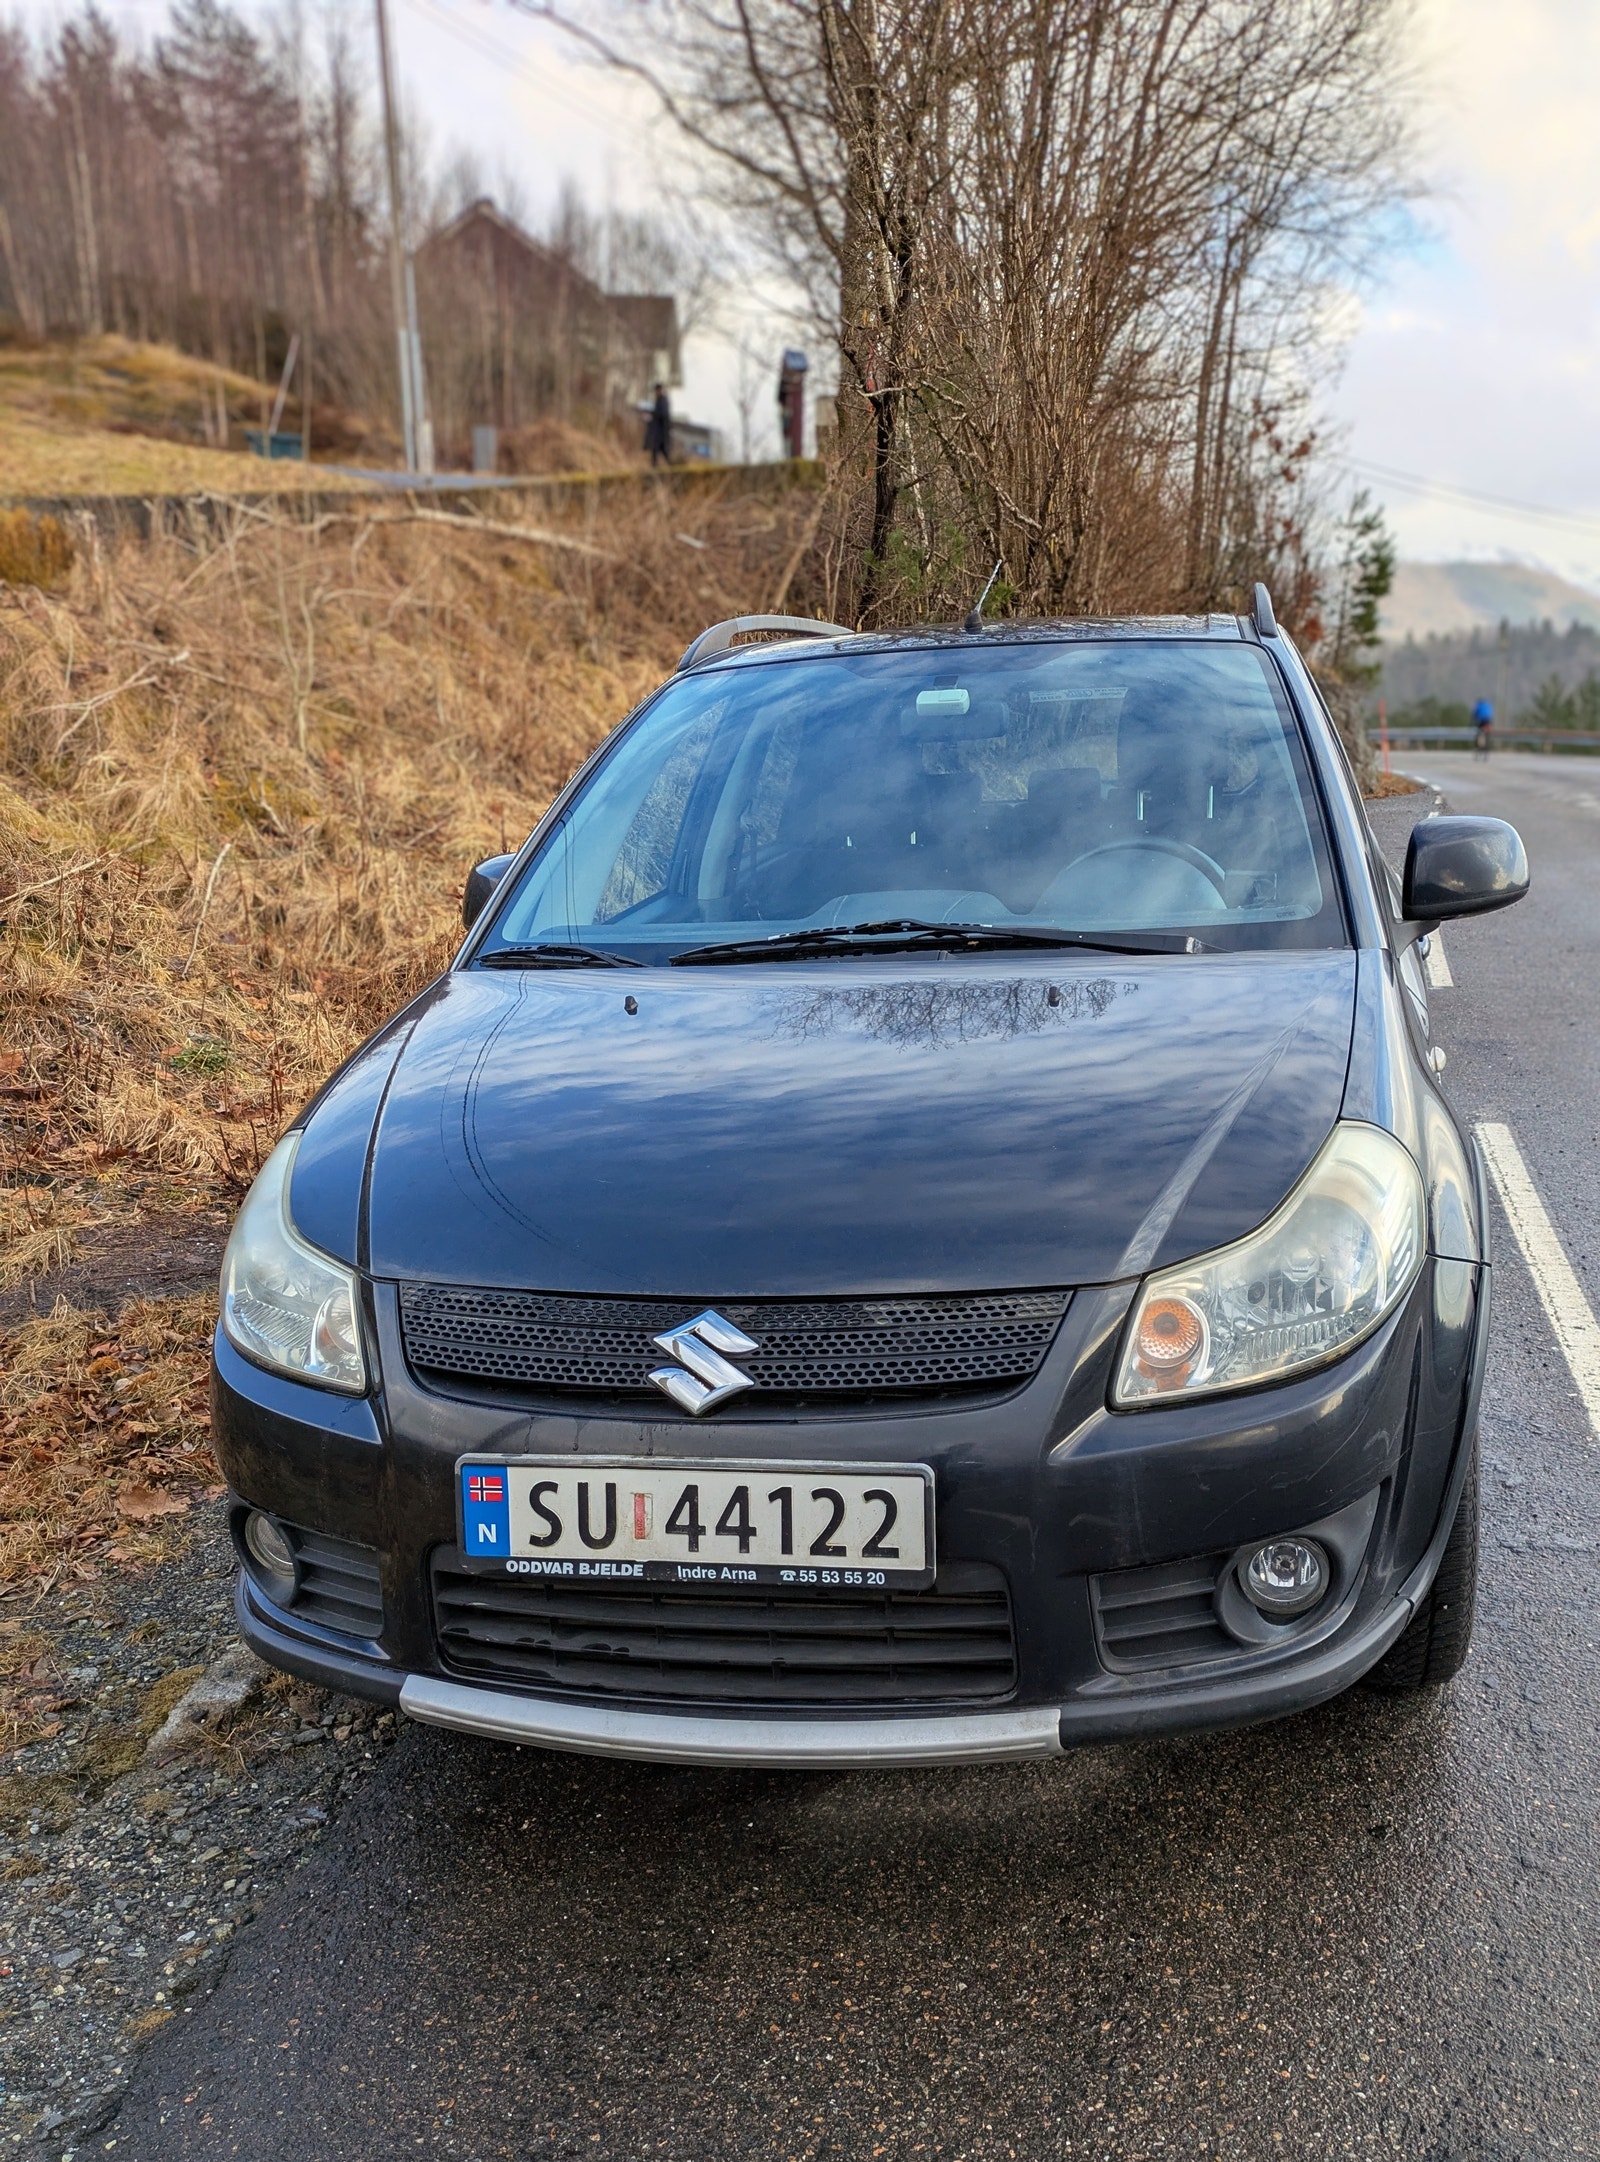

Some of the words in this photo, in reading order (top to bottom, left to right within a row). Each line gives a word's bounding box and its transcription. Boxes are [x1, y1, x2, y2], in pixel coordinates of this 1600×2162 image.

[529, 1480, 617, 1550] SU
[665, 1484, 900, 1558] 44122
[478, 1523, 497, 1544] N
[505, 1560, 574, 1575] ODDVAR
[579, 1563, 644, 1576] BJELDE
[677, 1565, 717, 1579] Indre
[720, 1567, 757, 1580] Arna
[799, 1570, 818, 1583] 55
[821, 1570, 840, 1583] 53
[844, 1571, 863, 1584] 55
[867, 1572, 885, 1585] 20
